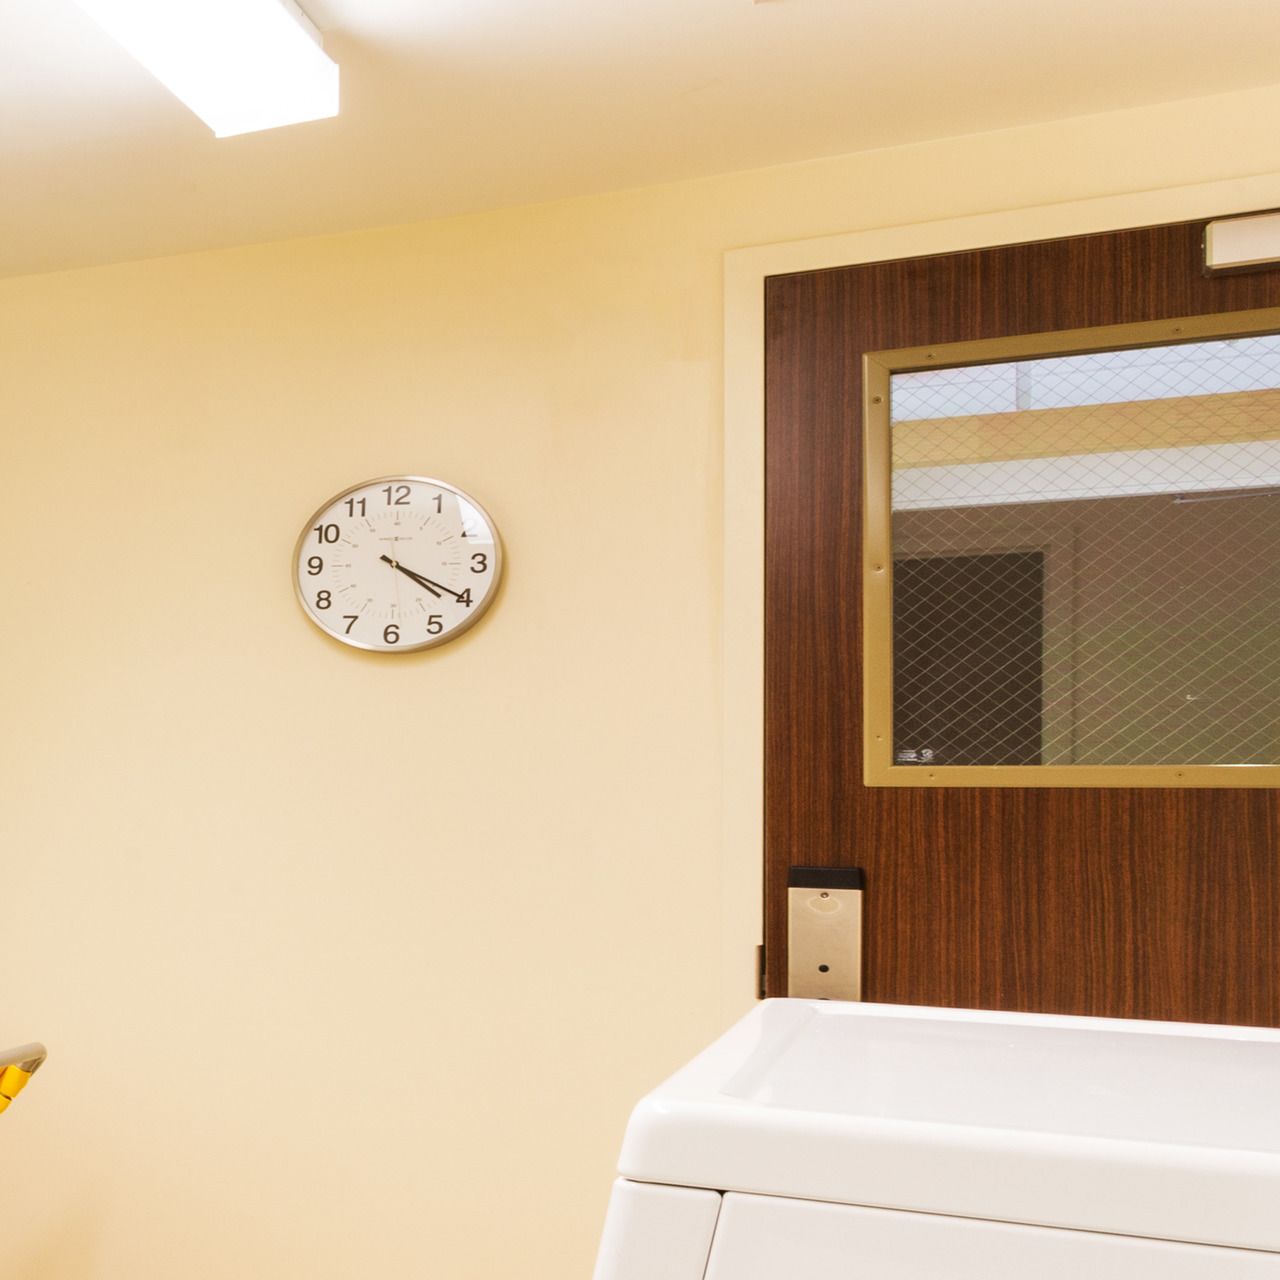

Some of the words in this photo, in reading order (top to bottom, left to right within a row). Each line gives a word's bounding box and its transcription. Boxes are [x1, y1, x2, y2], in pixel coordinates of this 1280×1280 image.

[382, 485, 411, 505] 12
[432, 494, 442, 514] 1
[344, 497, 366, 517] 11
[314, 523, 340, 544] 10
[307, 556, 323, 575] 9
[470, 553, 487, 573] 3
[316, 590, 332, 609] 8
[456, 588, 473, 607] 4
[342, 615, 358, 634] 7
[383, 624, 400, 644] 6
[426, 615, 443, 634] 5
